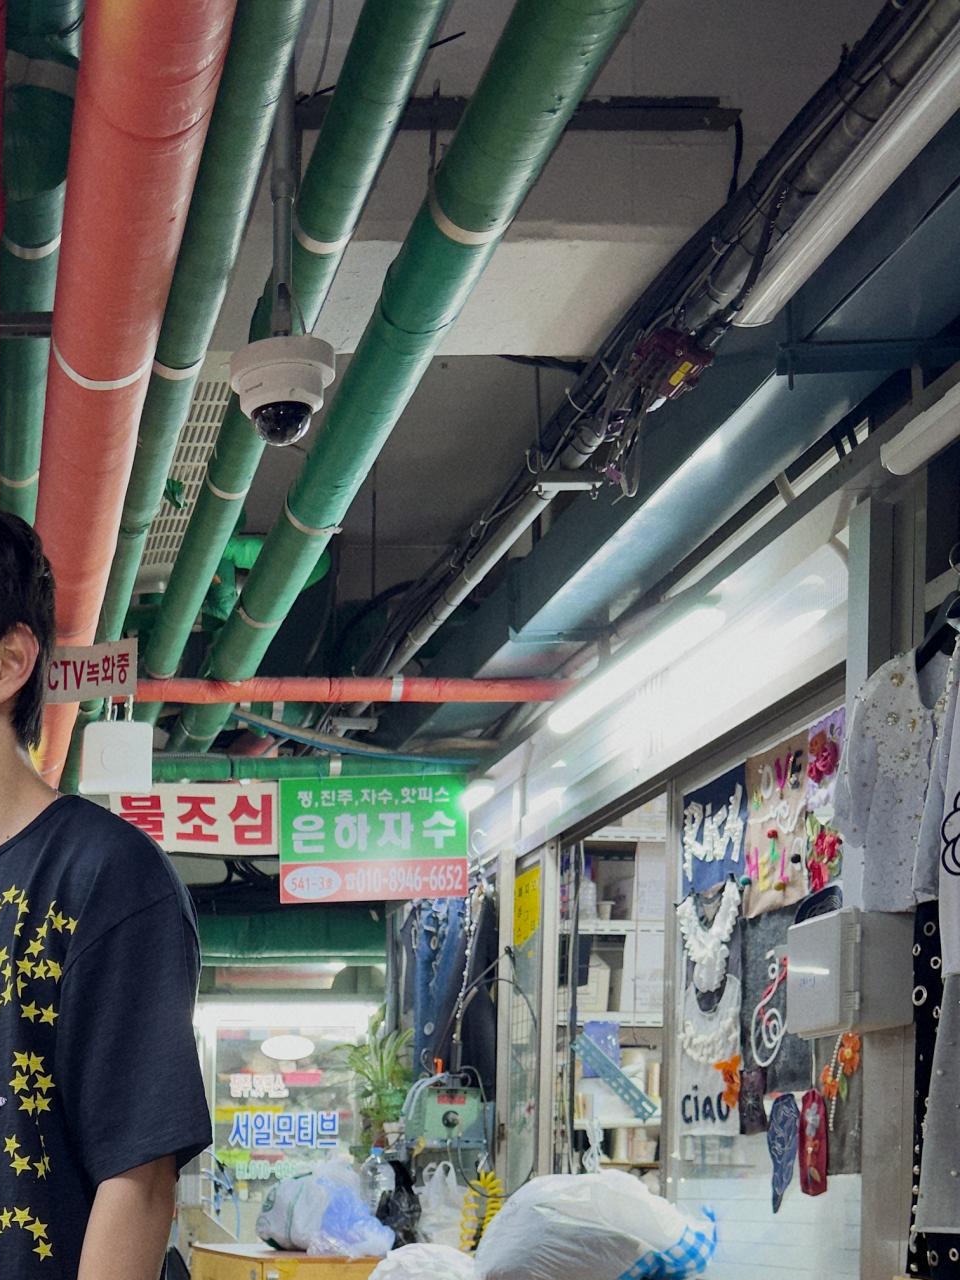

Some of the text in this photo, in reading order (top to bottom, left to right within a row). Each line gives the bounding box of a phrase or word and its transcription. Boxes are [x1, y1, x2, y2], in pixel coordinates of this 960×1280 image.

[119, 794, 273, 846] 불조심
[292, 811, 457, 855] 은하자수
[230, 1112, 339, 1148] 서일모티브
